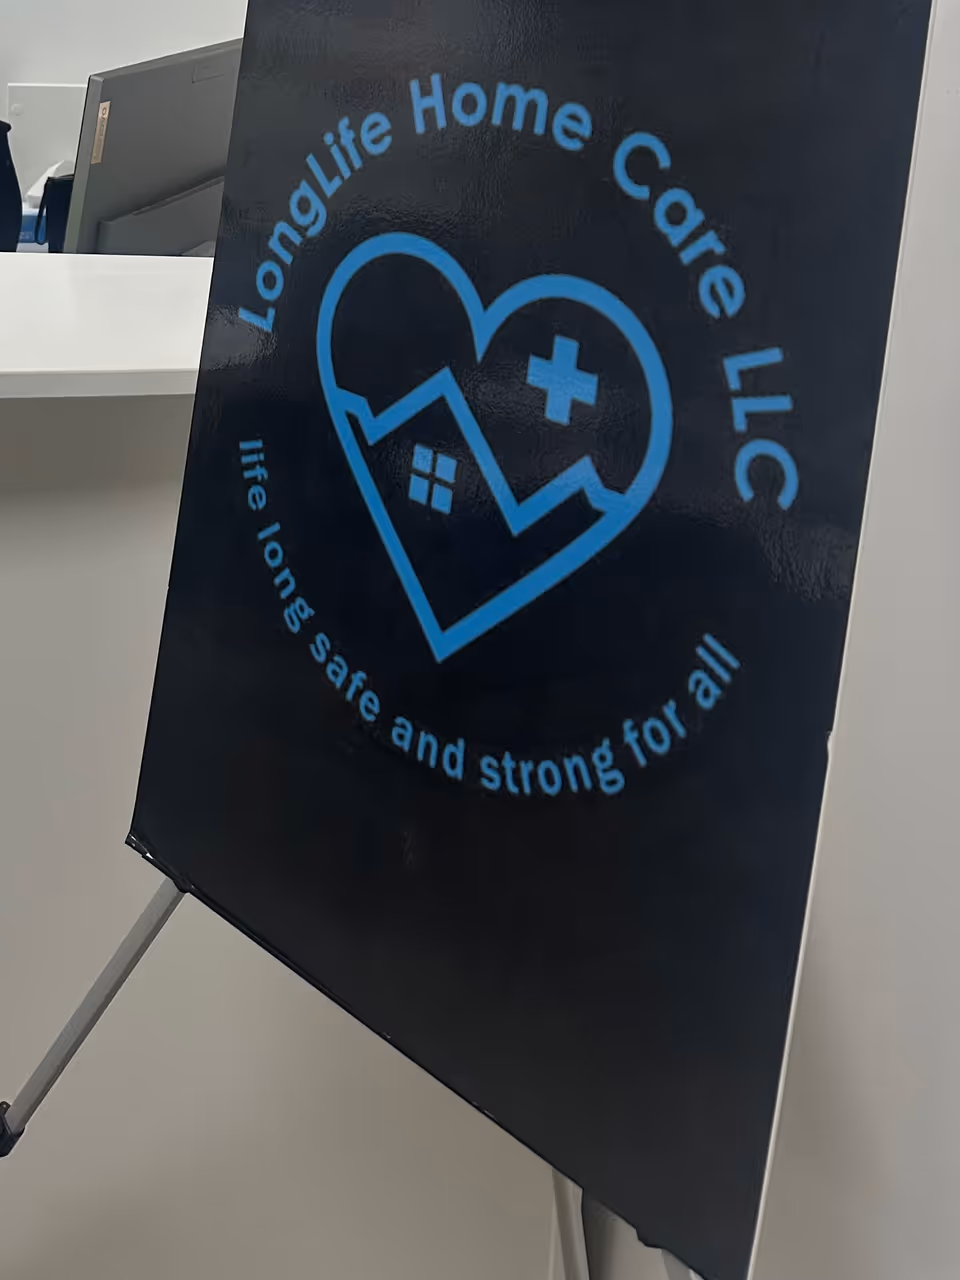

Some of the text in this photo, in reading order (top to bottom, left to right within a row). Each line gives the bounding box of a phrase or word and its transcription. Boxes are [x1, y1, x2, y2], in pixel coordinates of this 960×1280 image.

[239, 73, 799, 509] LongLife Home Care LLC
[240, 441, 740, 796] life long safe and strong for all
